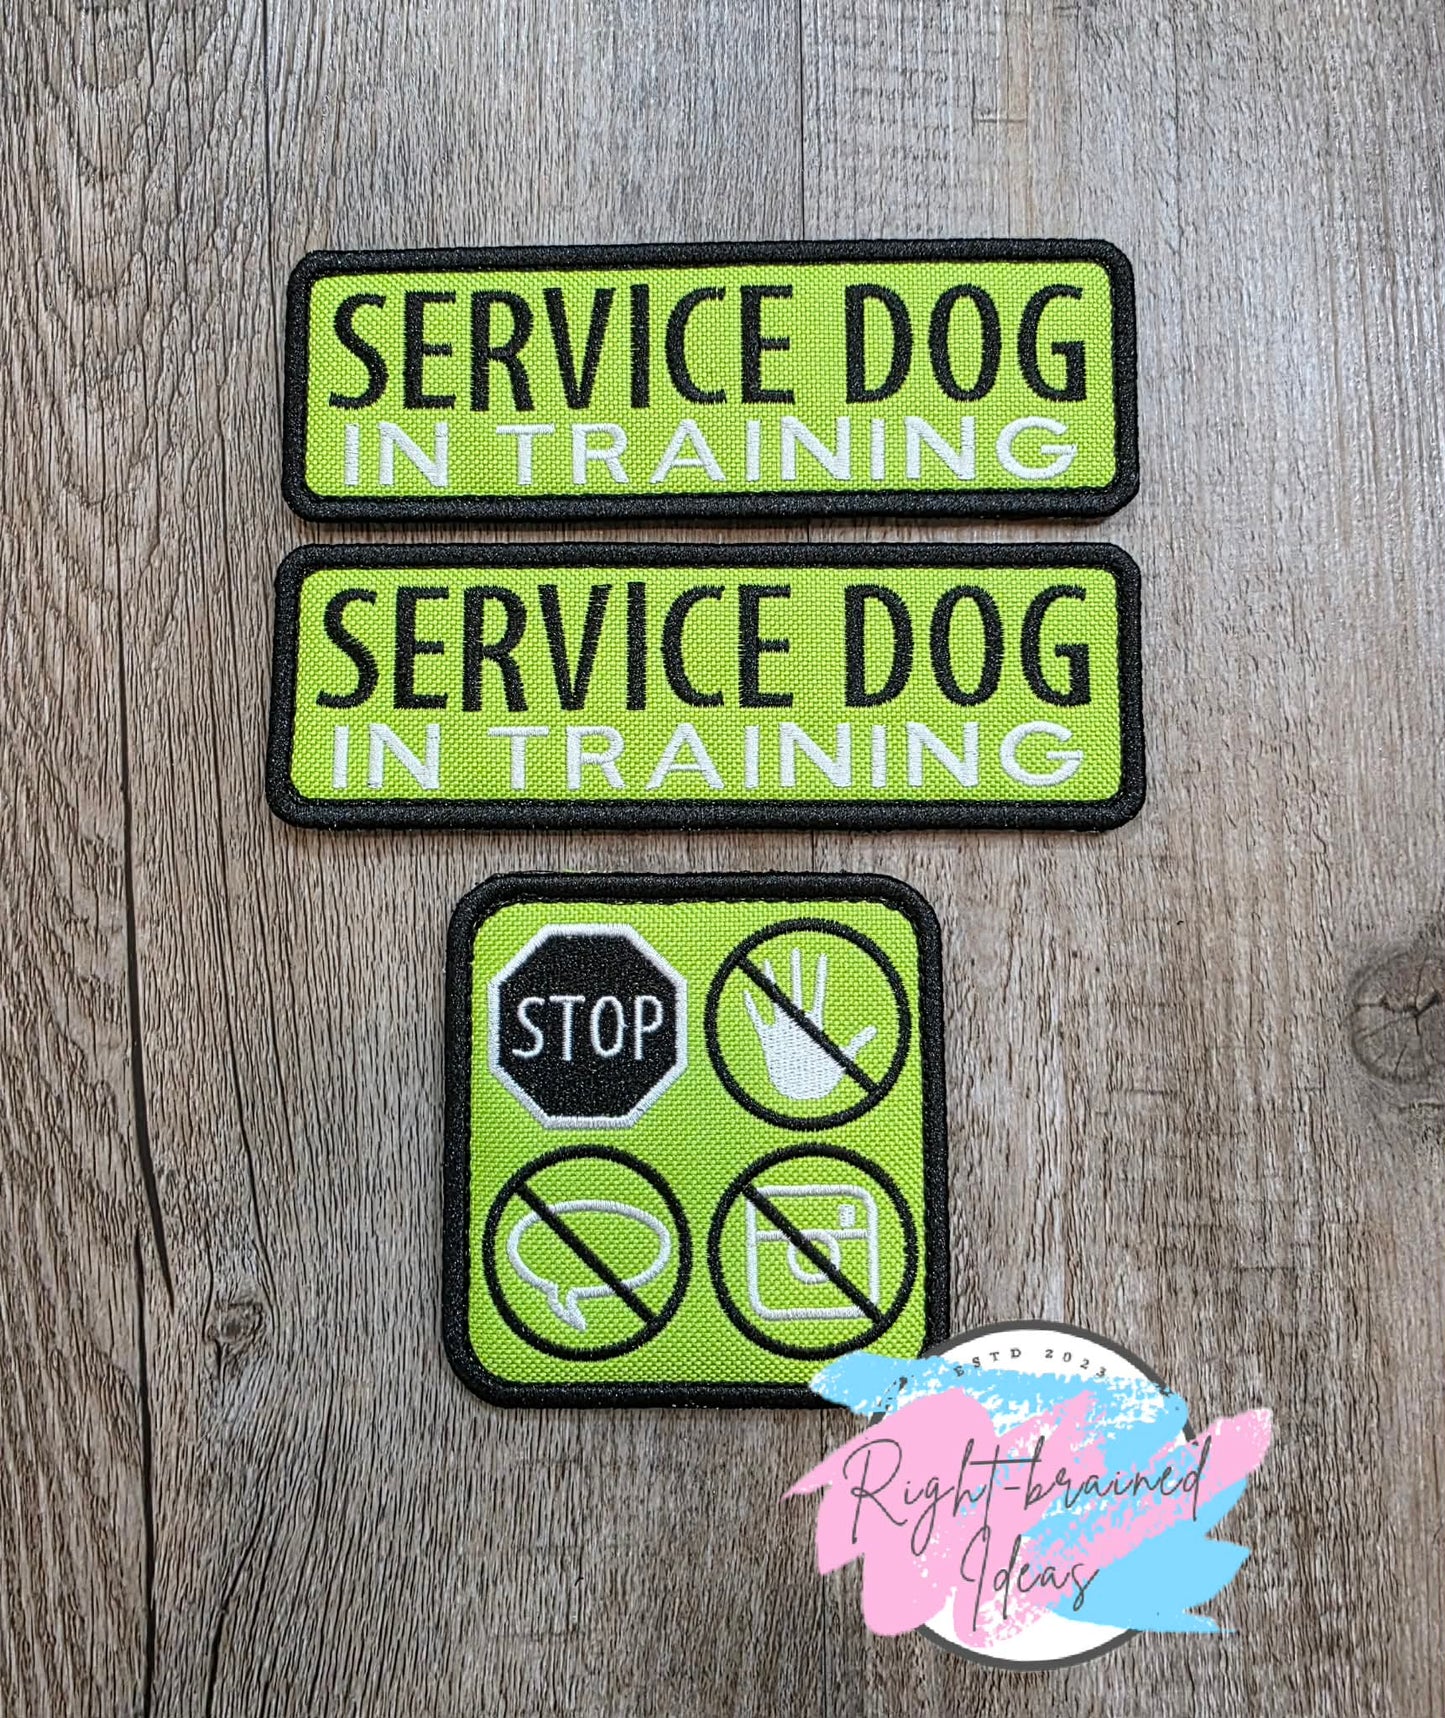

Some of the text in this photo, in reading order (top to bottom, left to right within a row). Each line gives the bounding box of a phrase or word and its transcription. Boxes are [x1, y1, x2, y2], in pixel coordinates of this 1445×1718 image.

[329, 283, 1087, 412] SERVICE DOG
[342, 415, 1078, 488] IN TRAINING
[315, 581, 1092, 712] SERVICE DOG
[332, 720, 1084, 790] IN TRAINING
[511, 995, 663, 1061] STOP
